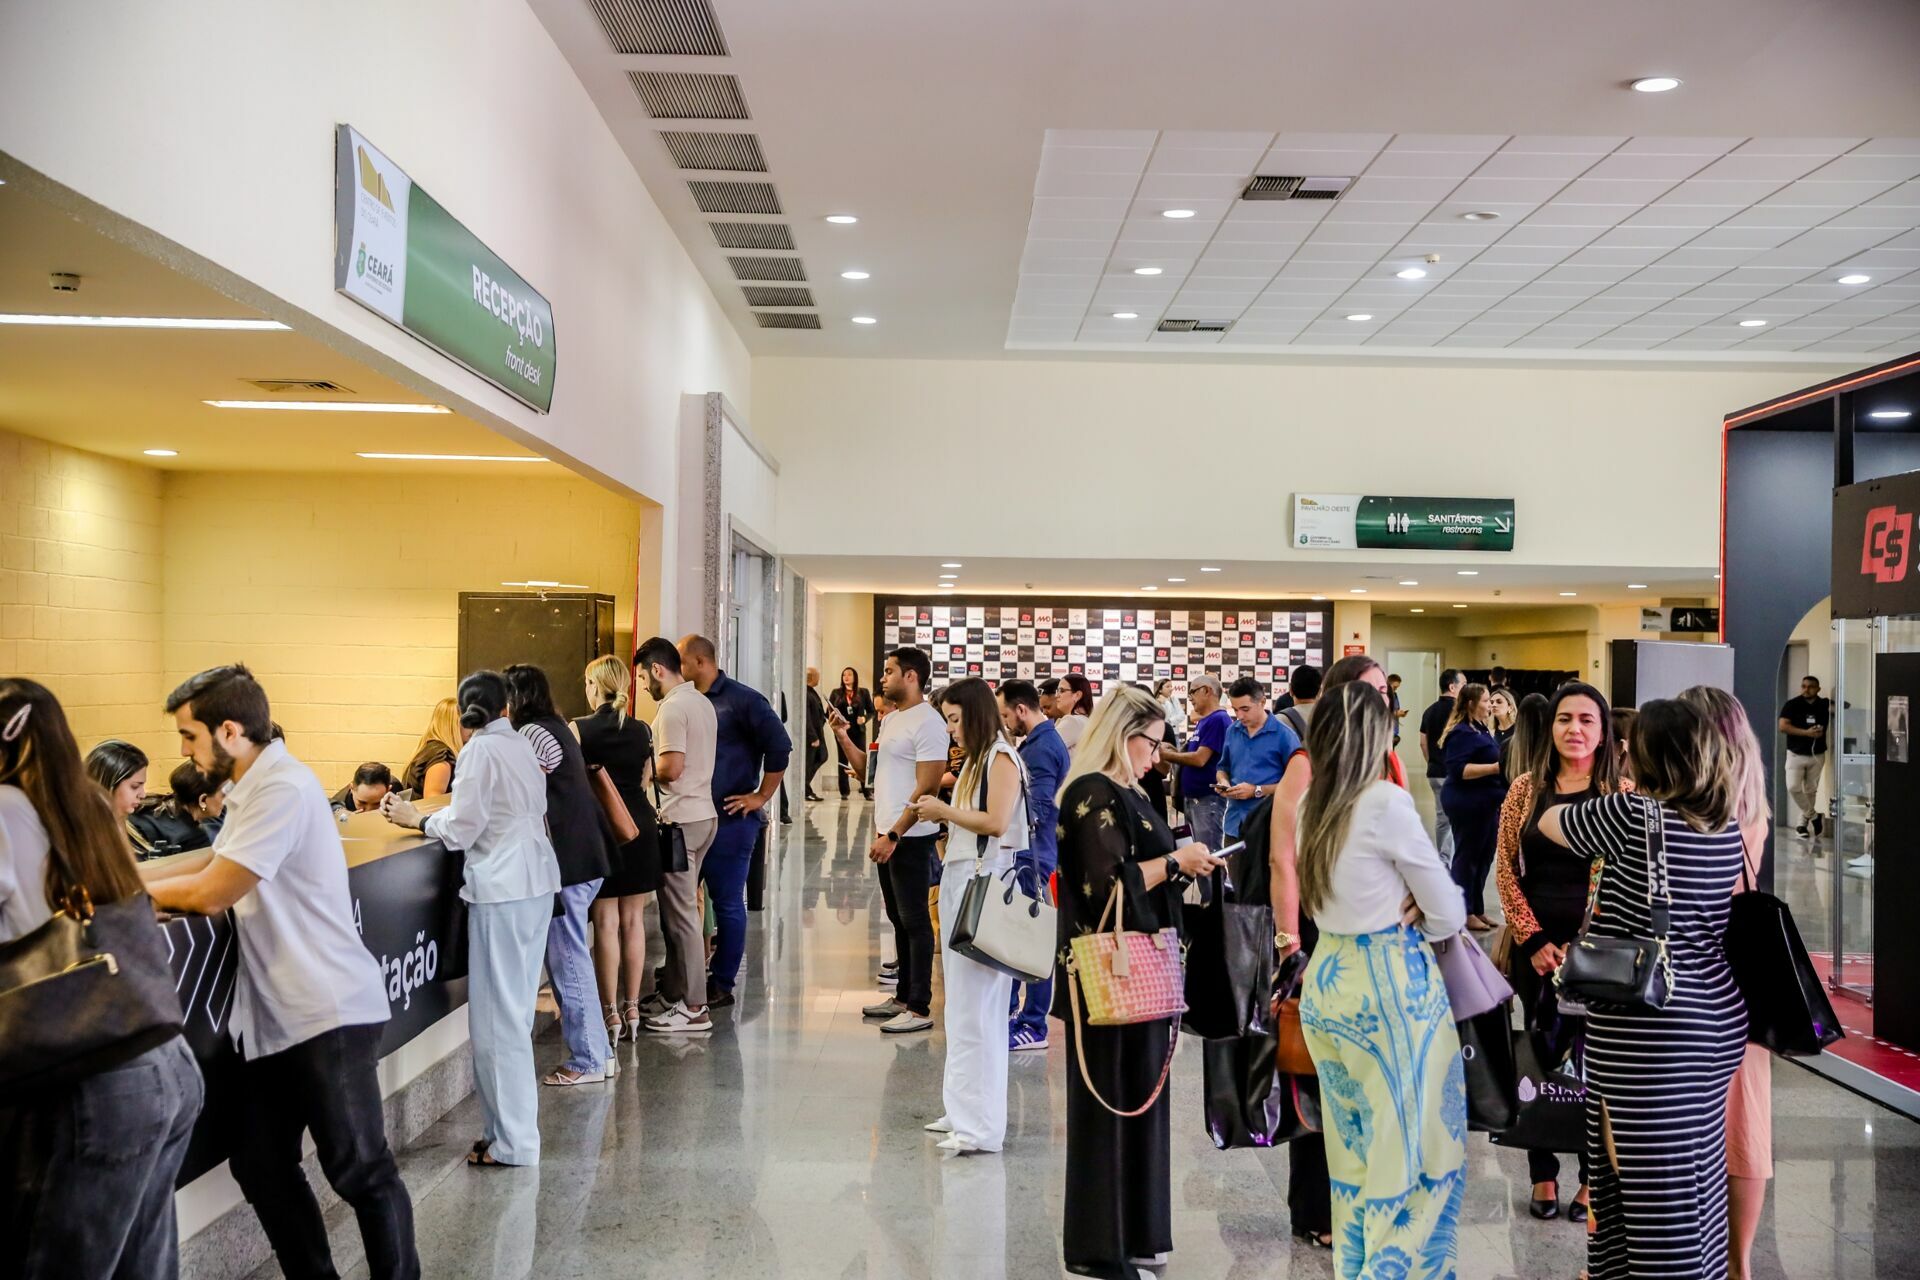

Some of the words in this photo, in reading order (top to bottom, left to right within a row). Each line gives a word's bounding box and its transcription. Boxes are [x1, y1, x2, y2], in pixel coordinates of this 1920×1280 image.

[367, 255, 393, 286] CEARÁ
[472, 264, 543, 348] RECEPÇÃO
[504, 345, 525, 376] front
[524, 360, 542, 386] desk
[1428, 512, 1483, 524] SANITÁRIOS
[1442, 525, 1482, 534] restrooms
